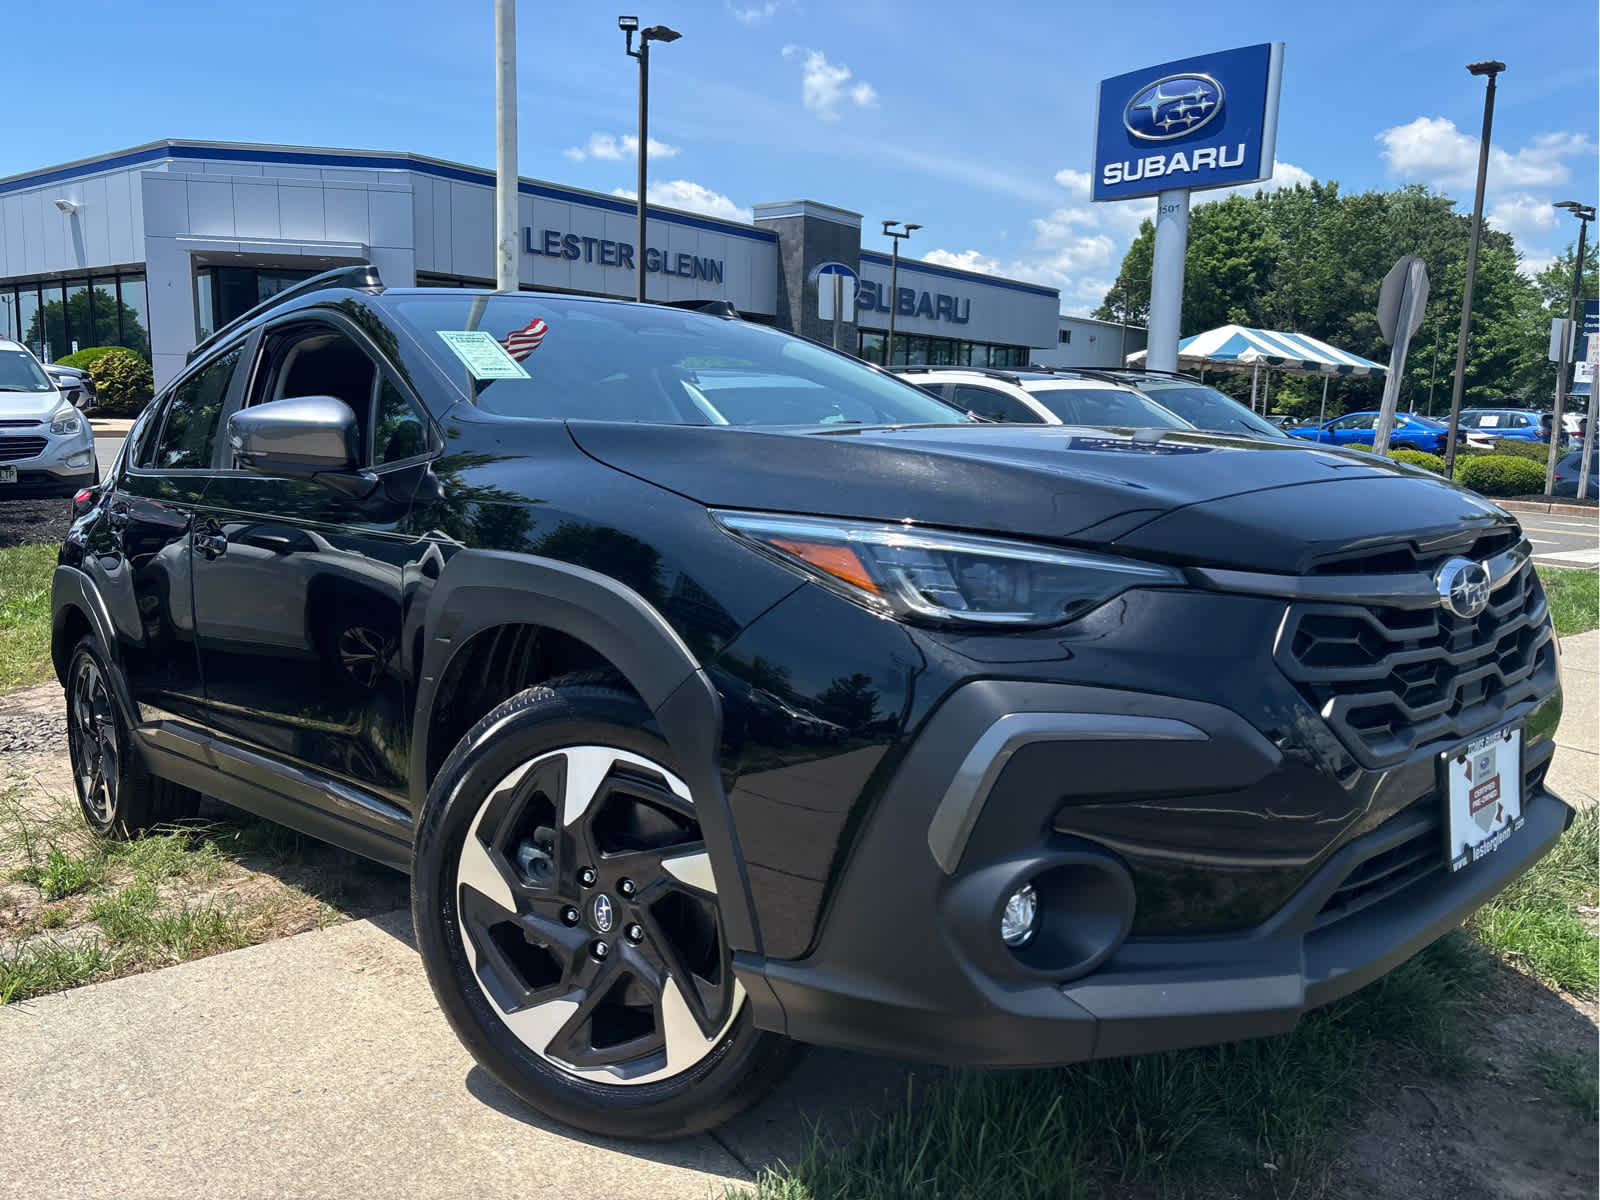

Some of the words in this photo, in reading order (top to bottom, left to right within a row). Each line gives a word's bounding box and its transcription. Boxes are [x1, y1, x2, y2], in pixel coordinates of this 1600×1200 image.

[1103, 143, 1246, 185] SUBARU
[1159, 204, 1181, 216] 1501
[523, 226, 636, 270] LESTER
[645, 247, 724, 284] GLENN
[856, 279, 971, 324] SUBARU
